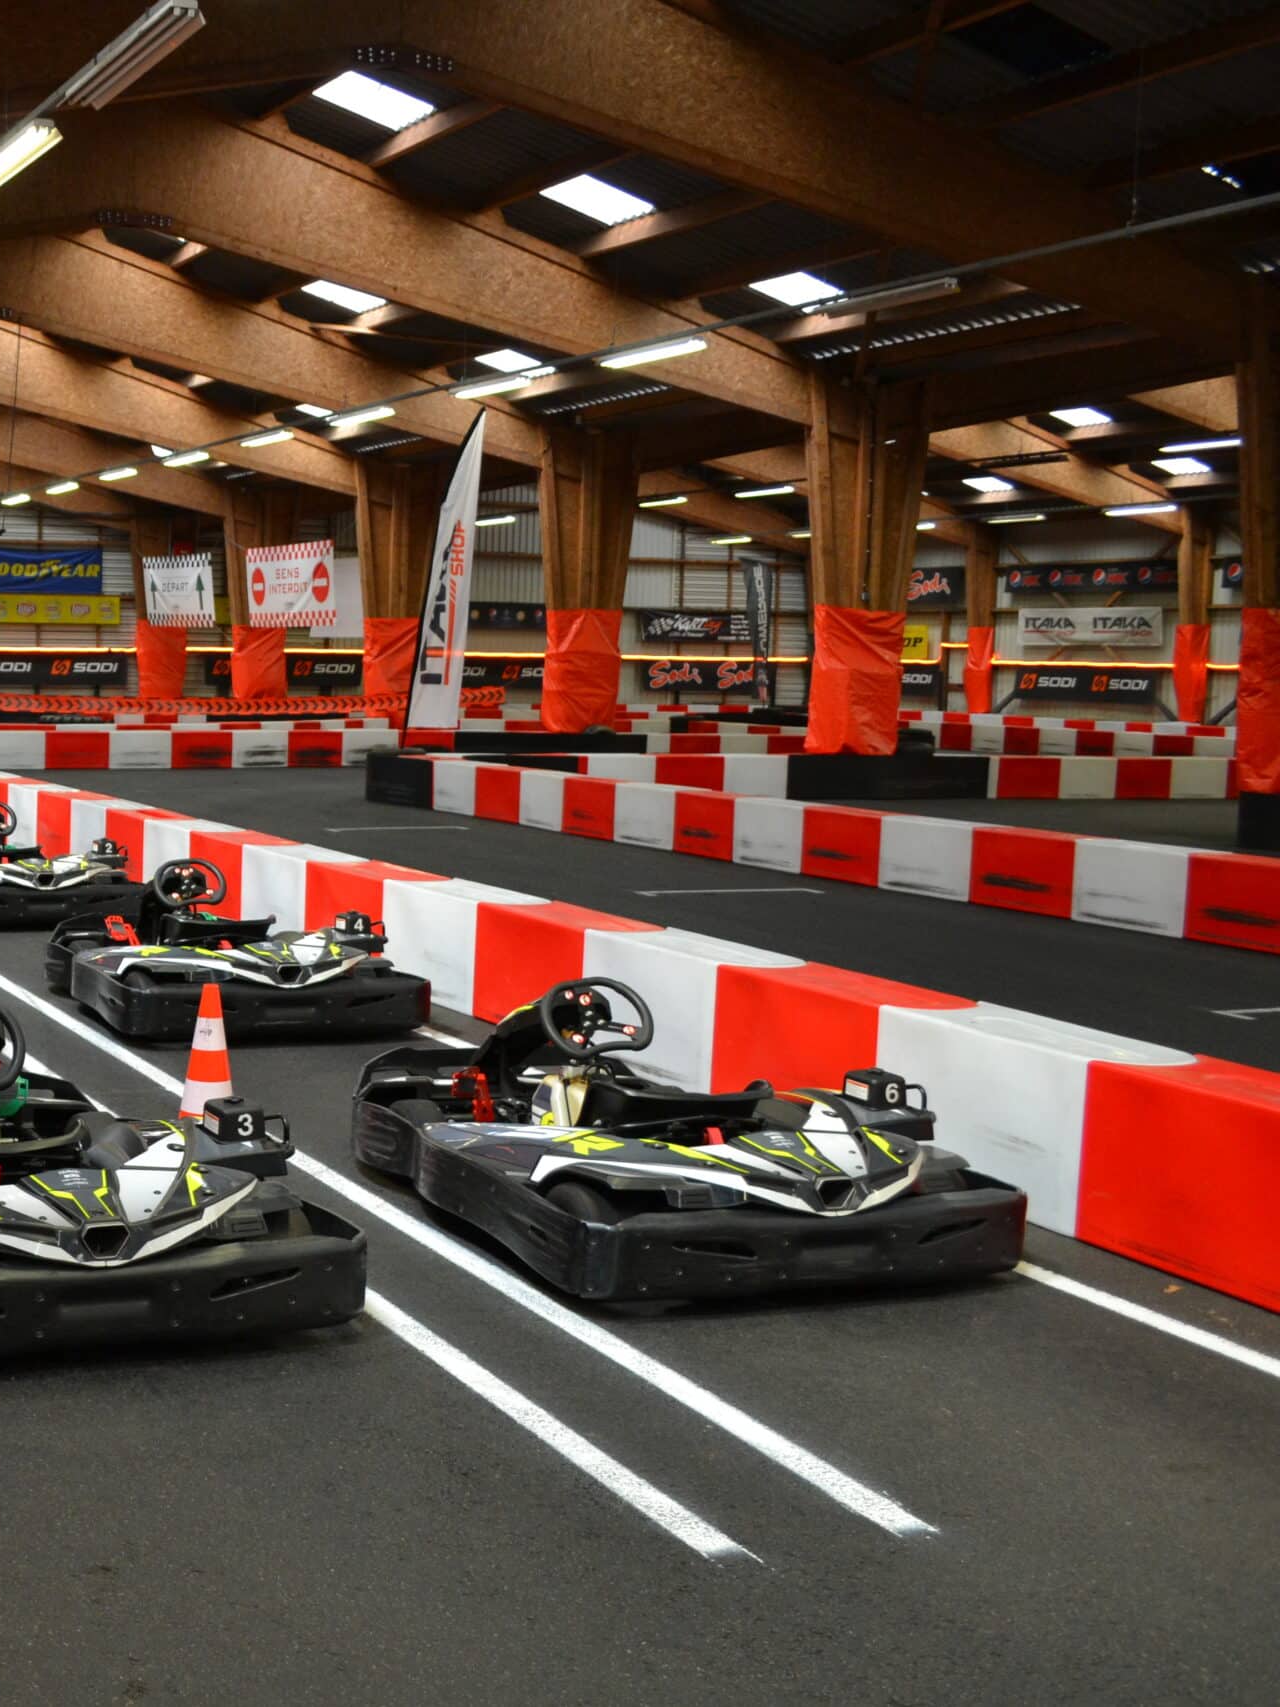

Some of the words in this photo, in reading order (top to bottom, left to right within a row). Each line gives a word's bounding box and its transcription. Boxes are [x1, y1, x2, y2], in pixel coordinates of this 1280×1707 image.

[275, 567, 300, 580] SENS
[162, 581, 189, 593] DÉPART
[906, 570, 951, 600] Sodi
[1024, 616, 1076, 629] ITAKA
[1093, 616, 1153, 629] ITAKA
[73, 661, 119, 673] SODI
[314, 663, 356, 675] SODI
[462, 666, 487, 676] ODI
[521, 667, 544, 677] SO
[648, 660, 703, 689] Sodi
[716, 660, 754, 689] Sod
[901, 673, 933, 684] SODI
[1037, 676, 1077, 688] SODI
[1108, 678, 1149, 691] SODI
[104, 842, 113, 854] 2
[353, 917, 365, 932] 4
[884, 1082, 899, 1104] 6
[237, 1113, 254, 1137] 3
